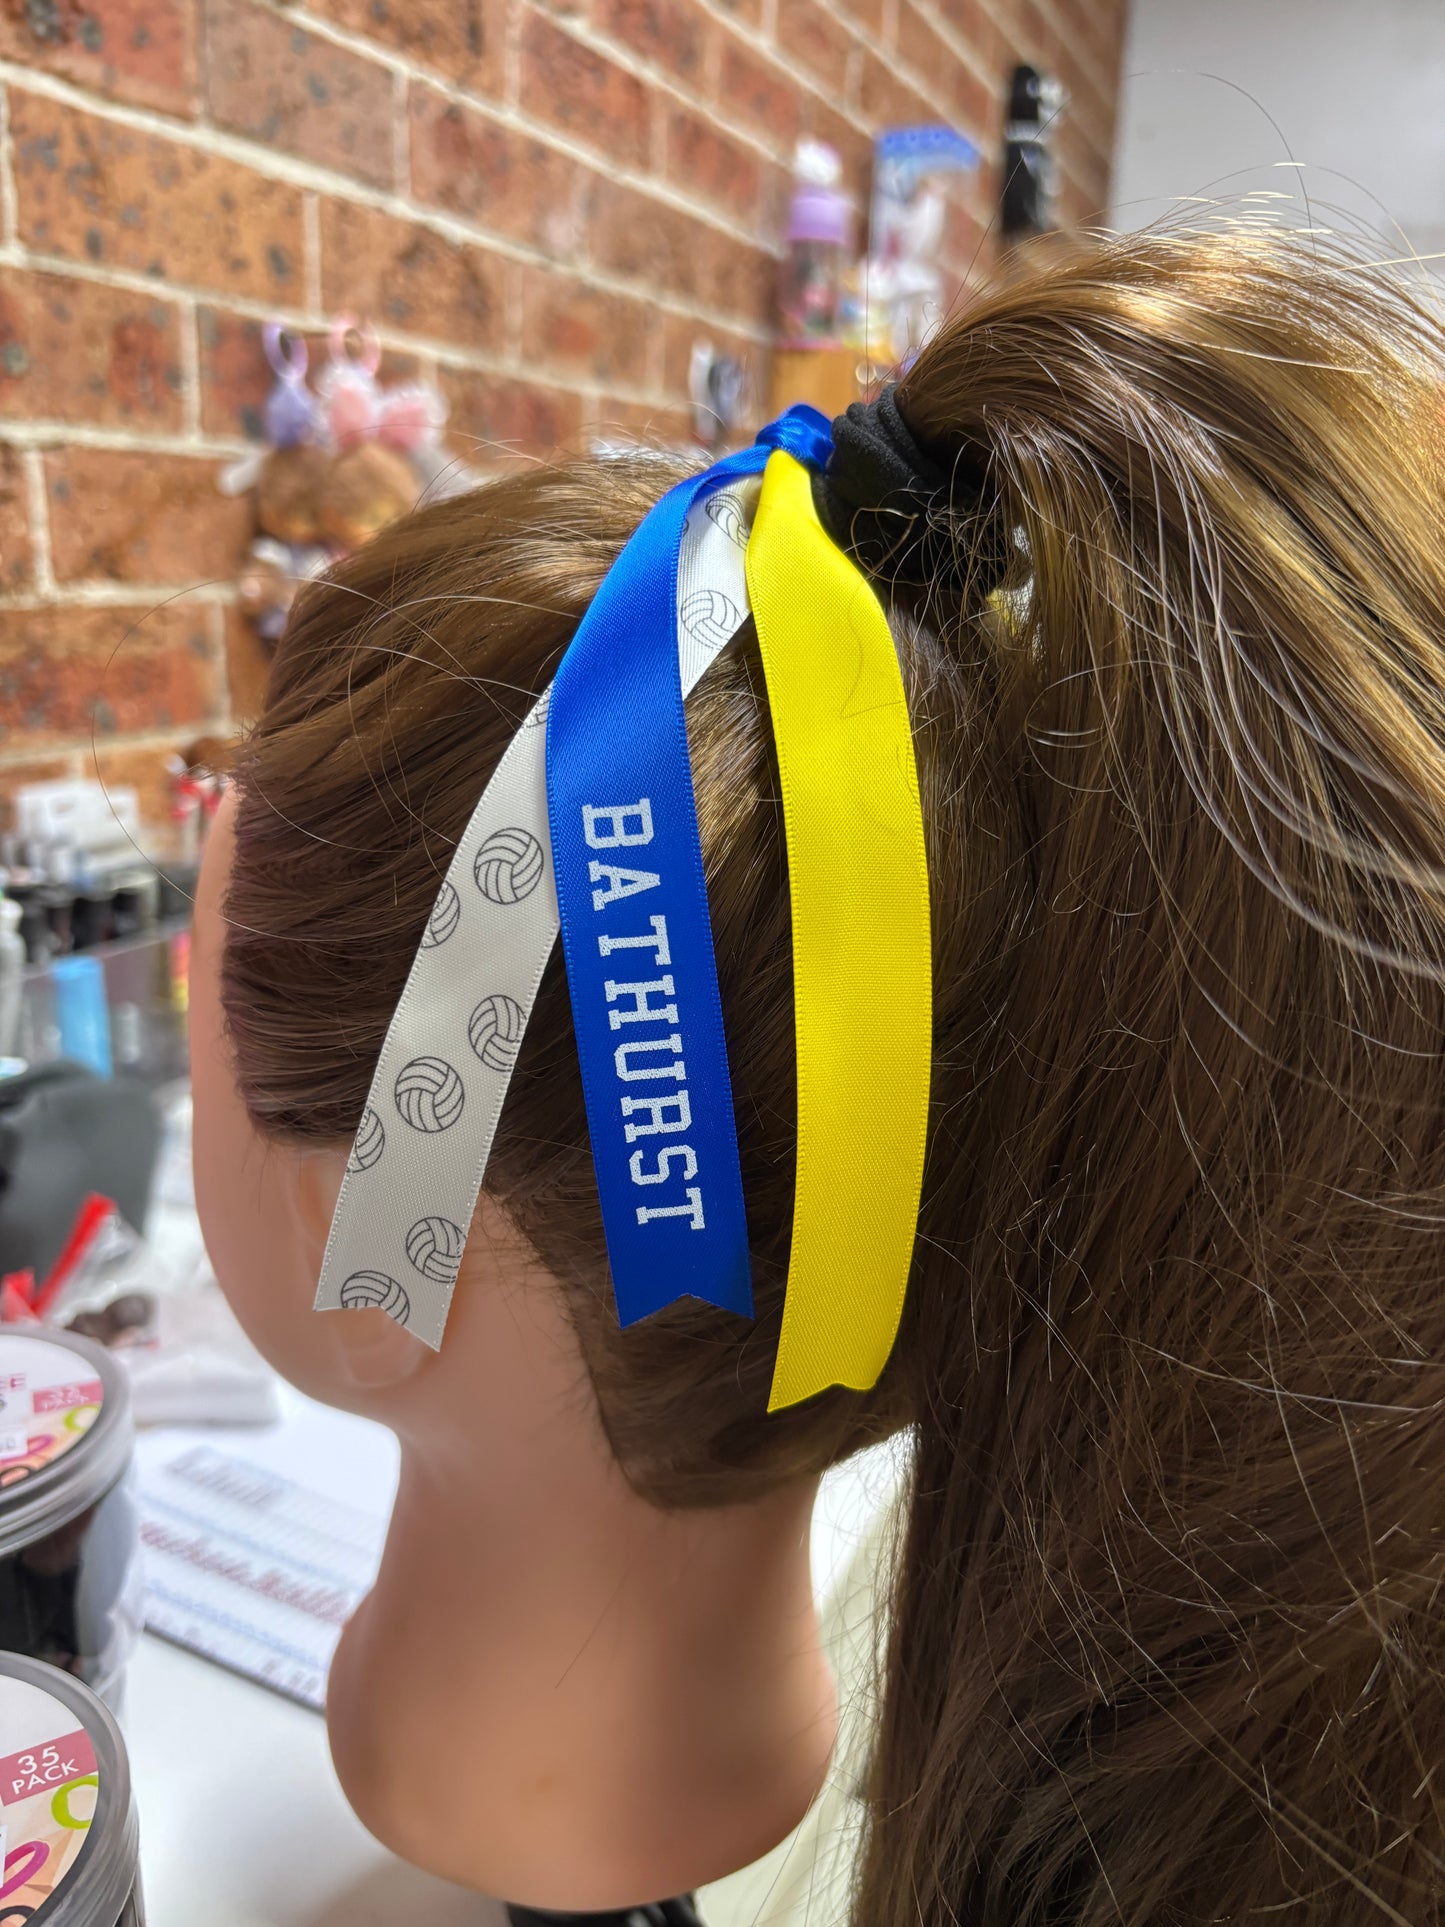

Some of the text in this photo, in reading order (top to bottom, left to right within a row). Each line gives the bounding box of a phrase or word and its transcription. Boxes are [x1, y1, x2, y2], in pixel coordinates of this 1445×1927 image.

[581, 797, 706, 1231] BATHURST
[11, 1758, 80, 1795] PACK
[17, 1745, 60, 1775] 35
